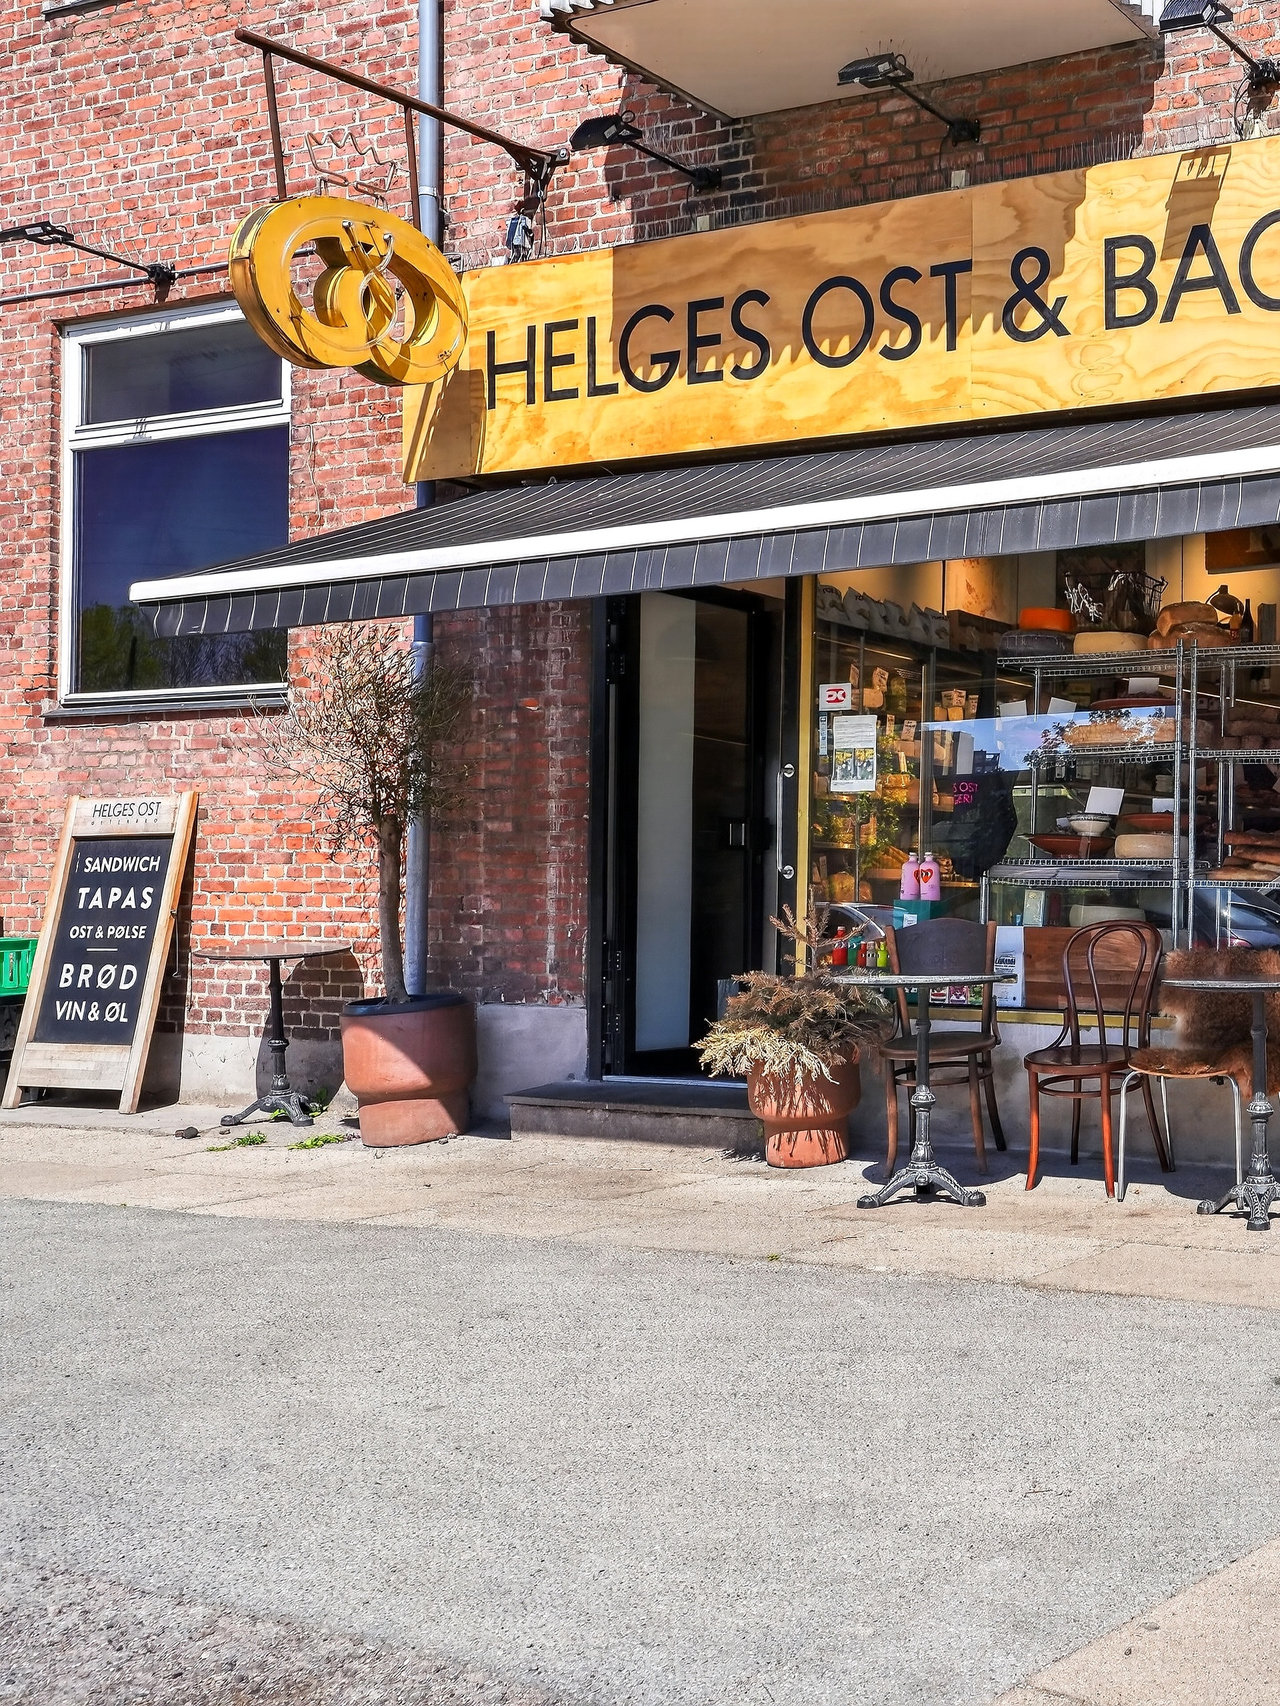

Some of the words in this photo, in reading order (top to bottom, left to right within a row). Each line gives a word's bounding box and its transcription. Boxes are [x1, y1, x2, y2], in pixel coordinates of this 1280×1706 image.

[487, 289, 771, 410] HELGES
[802, 259, 973, 368] OST
[1002, 246, 1071, 342] &
[92, 802, 136, 818] HELGES
[137, 801, 162, 817] OST
[83, 855, 161, 873] SANDWICH
[78, 886, 154, 910] TAPAS
[69, 925, 93, 939] OST
[95, 925, 104, 939] &
[107, 924, 148, 940] PØLSE
[59, 963, 138, 990] BRØD
[55, 1001, 87, 1021] VIN
[87, 1001, 100, 1021] &
[104, 1002, 129, 1023] ØL
